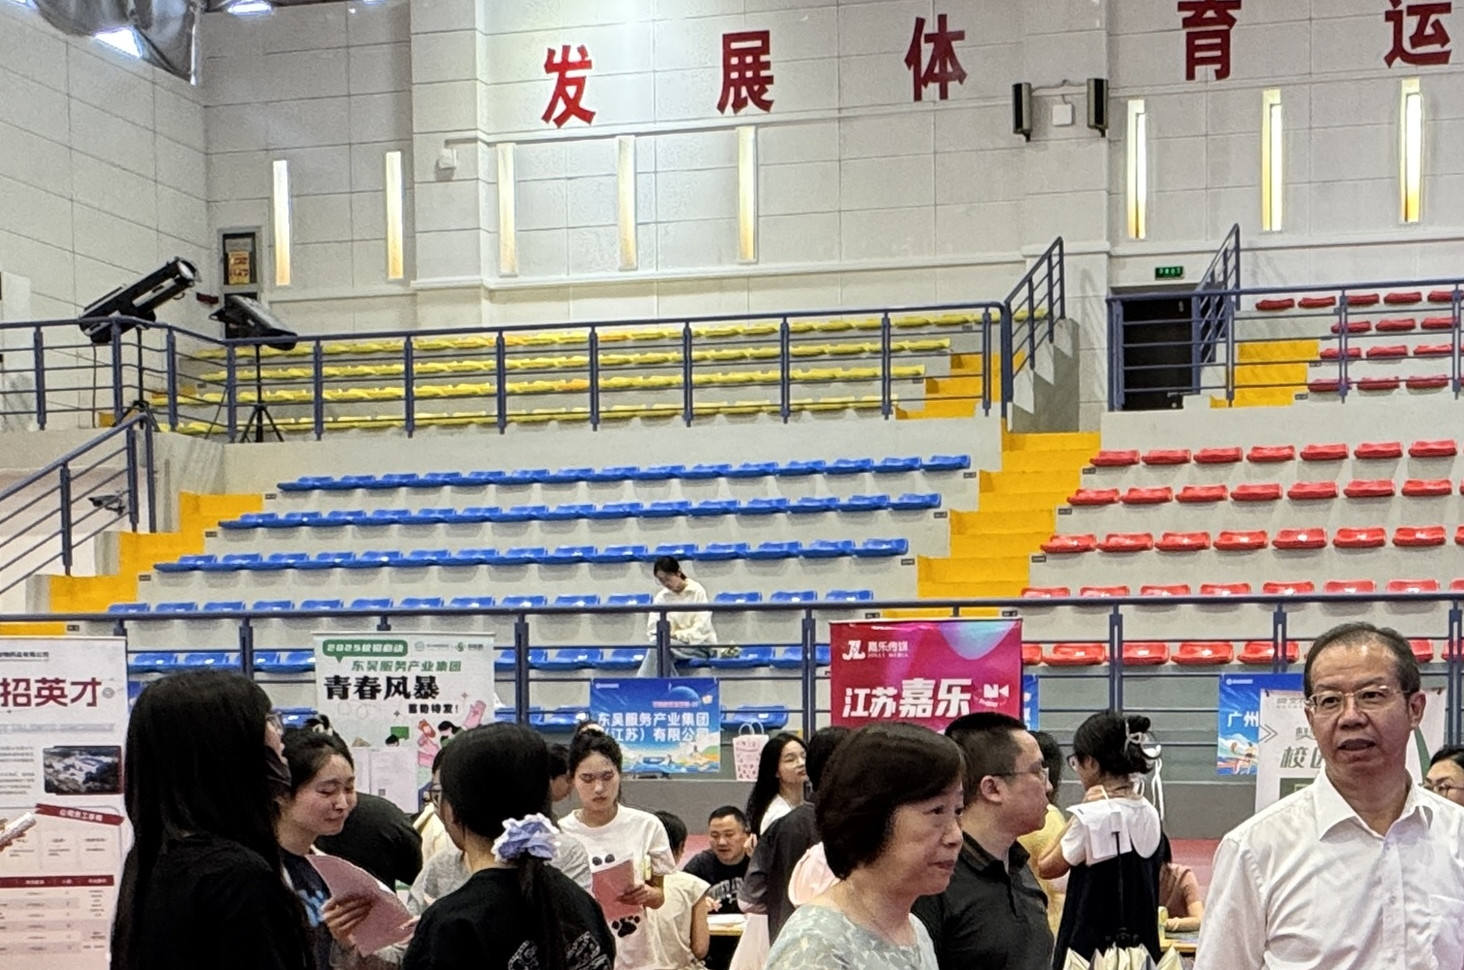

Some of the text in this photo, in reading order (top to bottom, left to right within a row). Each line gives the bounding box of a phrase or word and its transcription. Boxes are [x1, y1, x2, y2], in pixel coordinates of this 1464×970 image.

[351, 660, 462, 672] 东吴服务产业集团
[0, 677, 102, 708] 招英才
[324, 675, 440, 700] 青春风暴
[842, 677, 973, 719] 江苏嘉乐
[598, 712, 710, 727] 东吴服务产业集团
[1227, 711, 1259, 728] 广州
